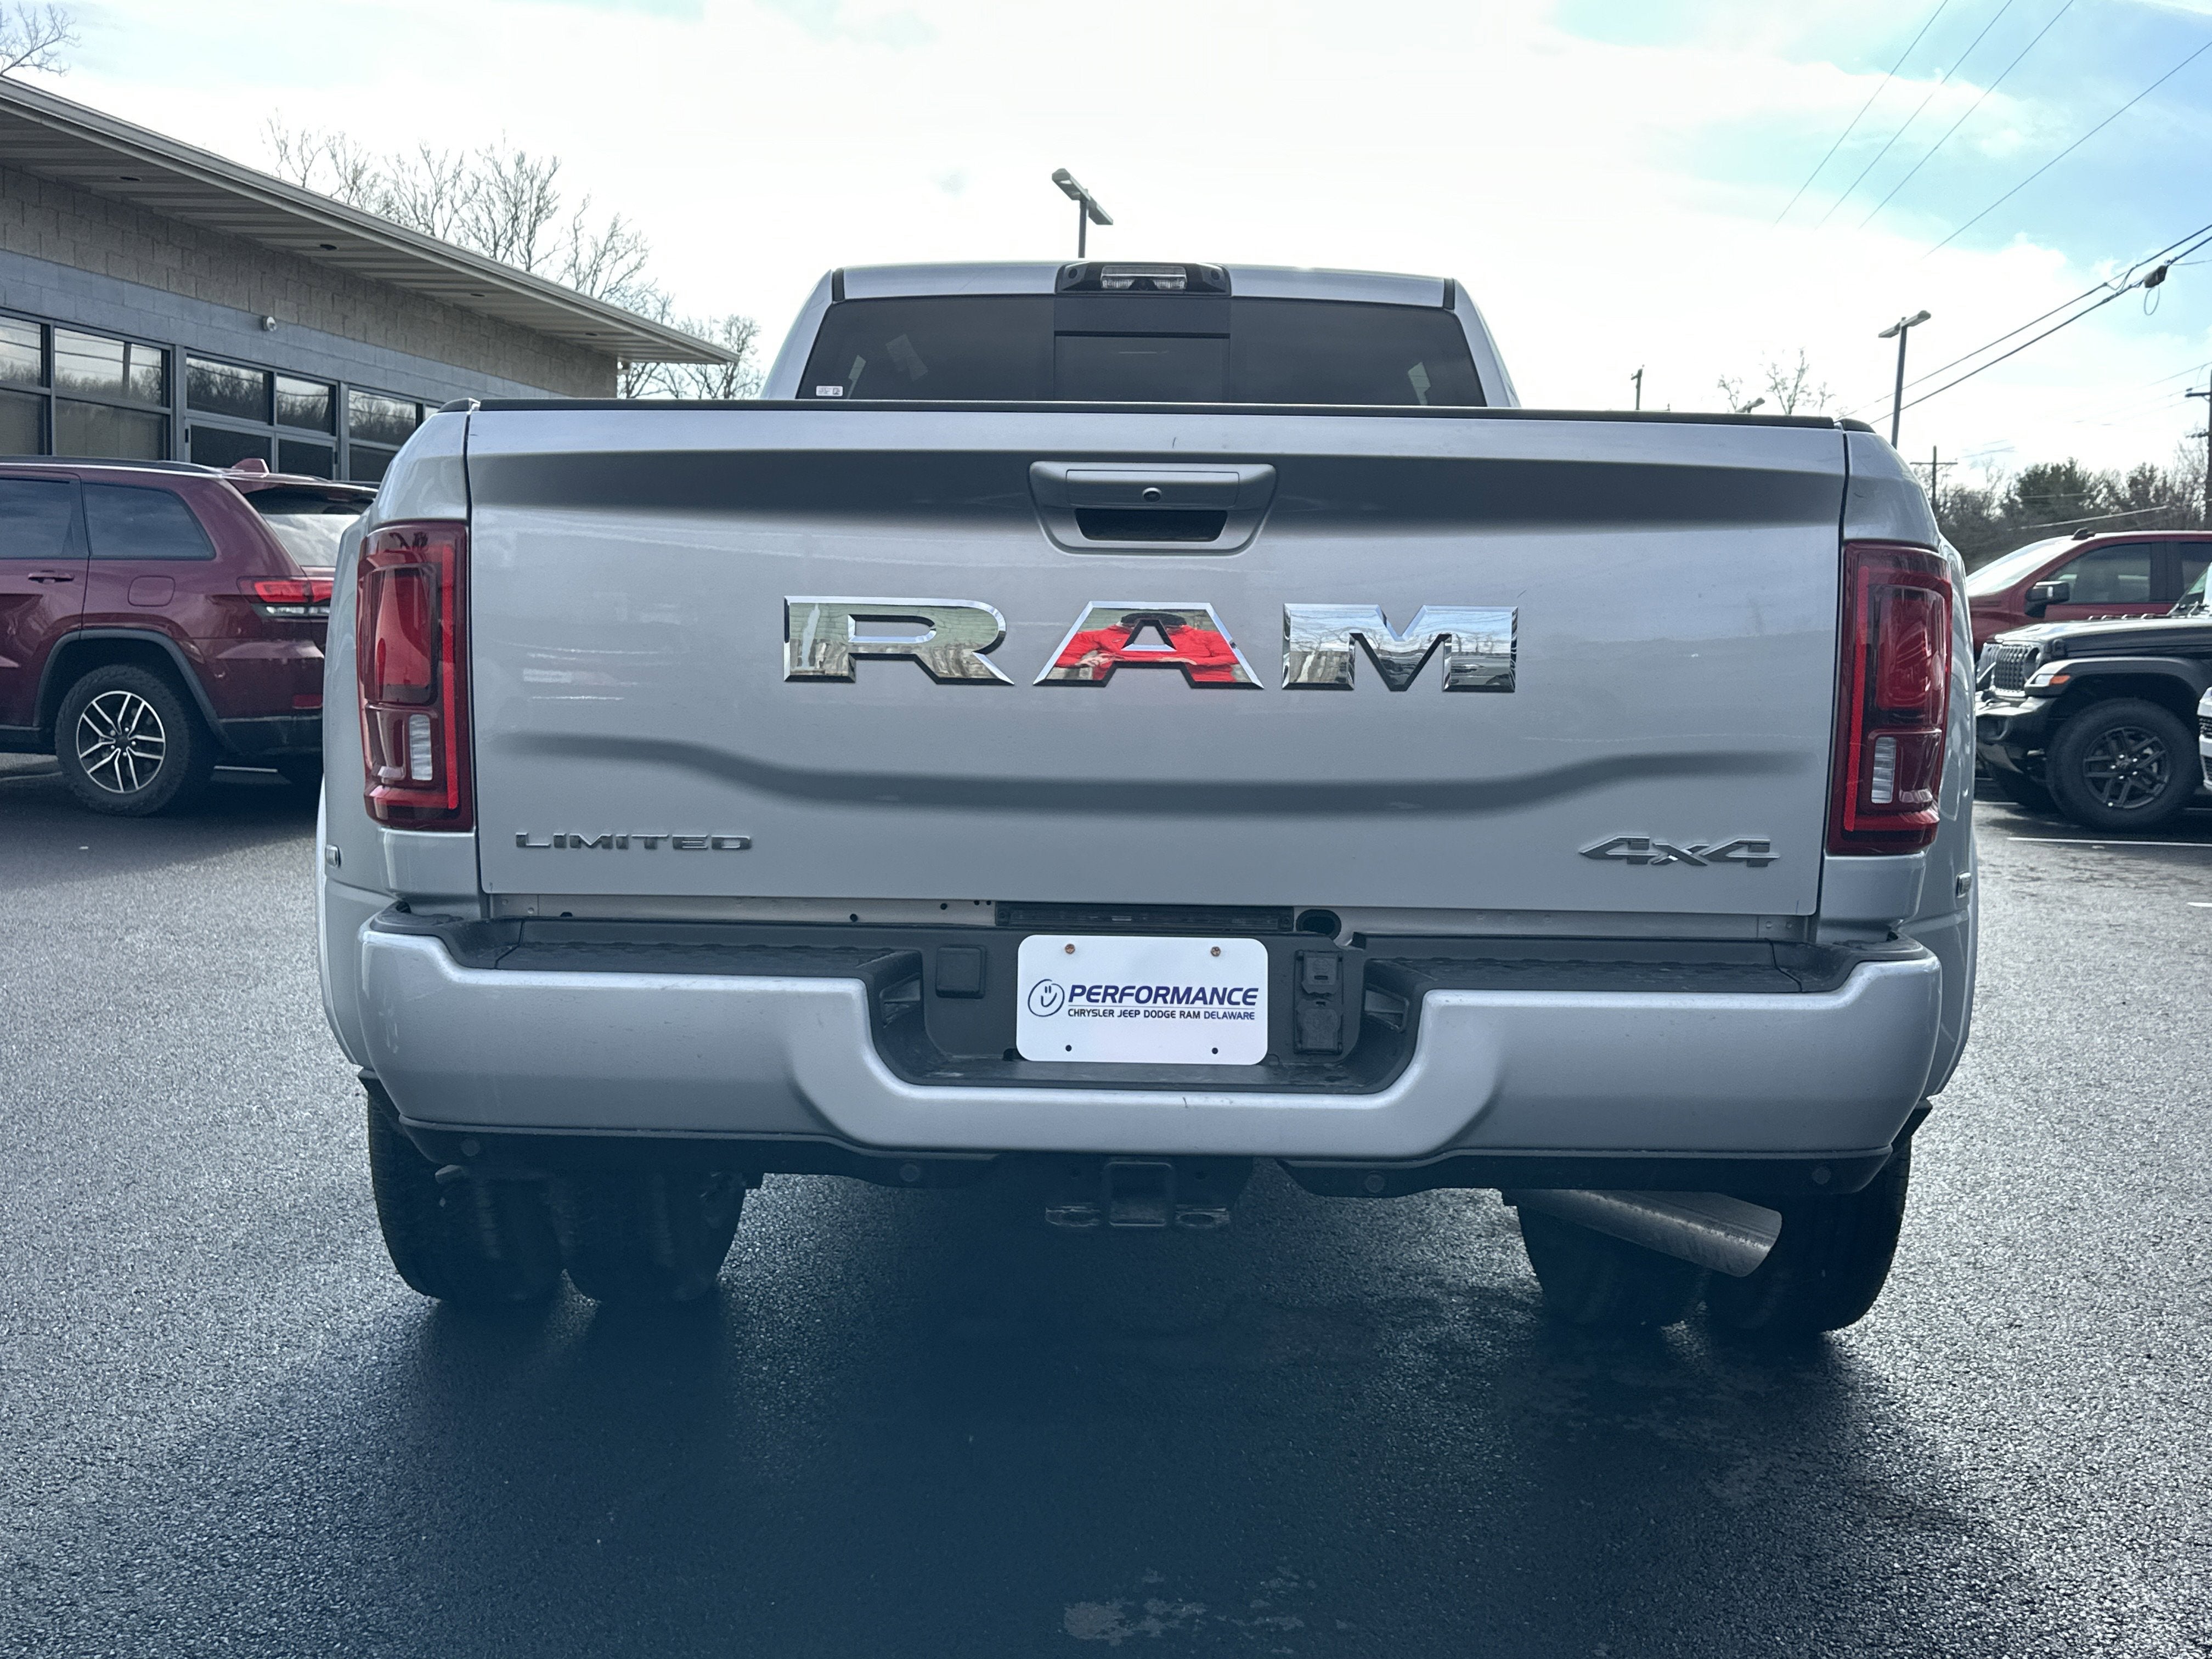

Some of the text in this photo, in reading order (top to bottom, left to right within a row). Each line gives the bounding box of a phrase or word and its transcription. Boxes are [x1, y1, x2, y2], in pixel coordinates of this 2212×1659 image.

[783, 595, 1519, 692] RAM
[515, 832, 752, 850] LIMITED
[1068, 984, 1259, 1006] PERFORMANCE
[1068, 1008, 1255, 1020] CHRYSLER JEEP DODGE RAM DELAWARE
